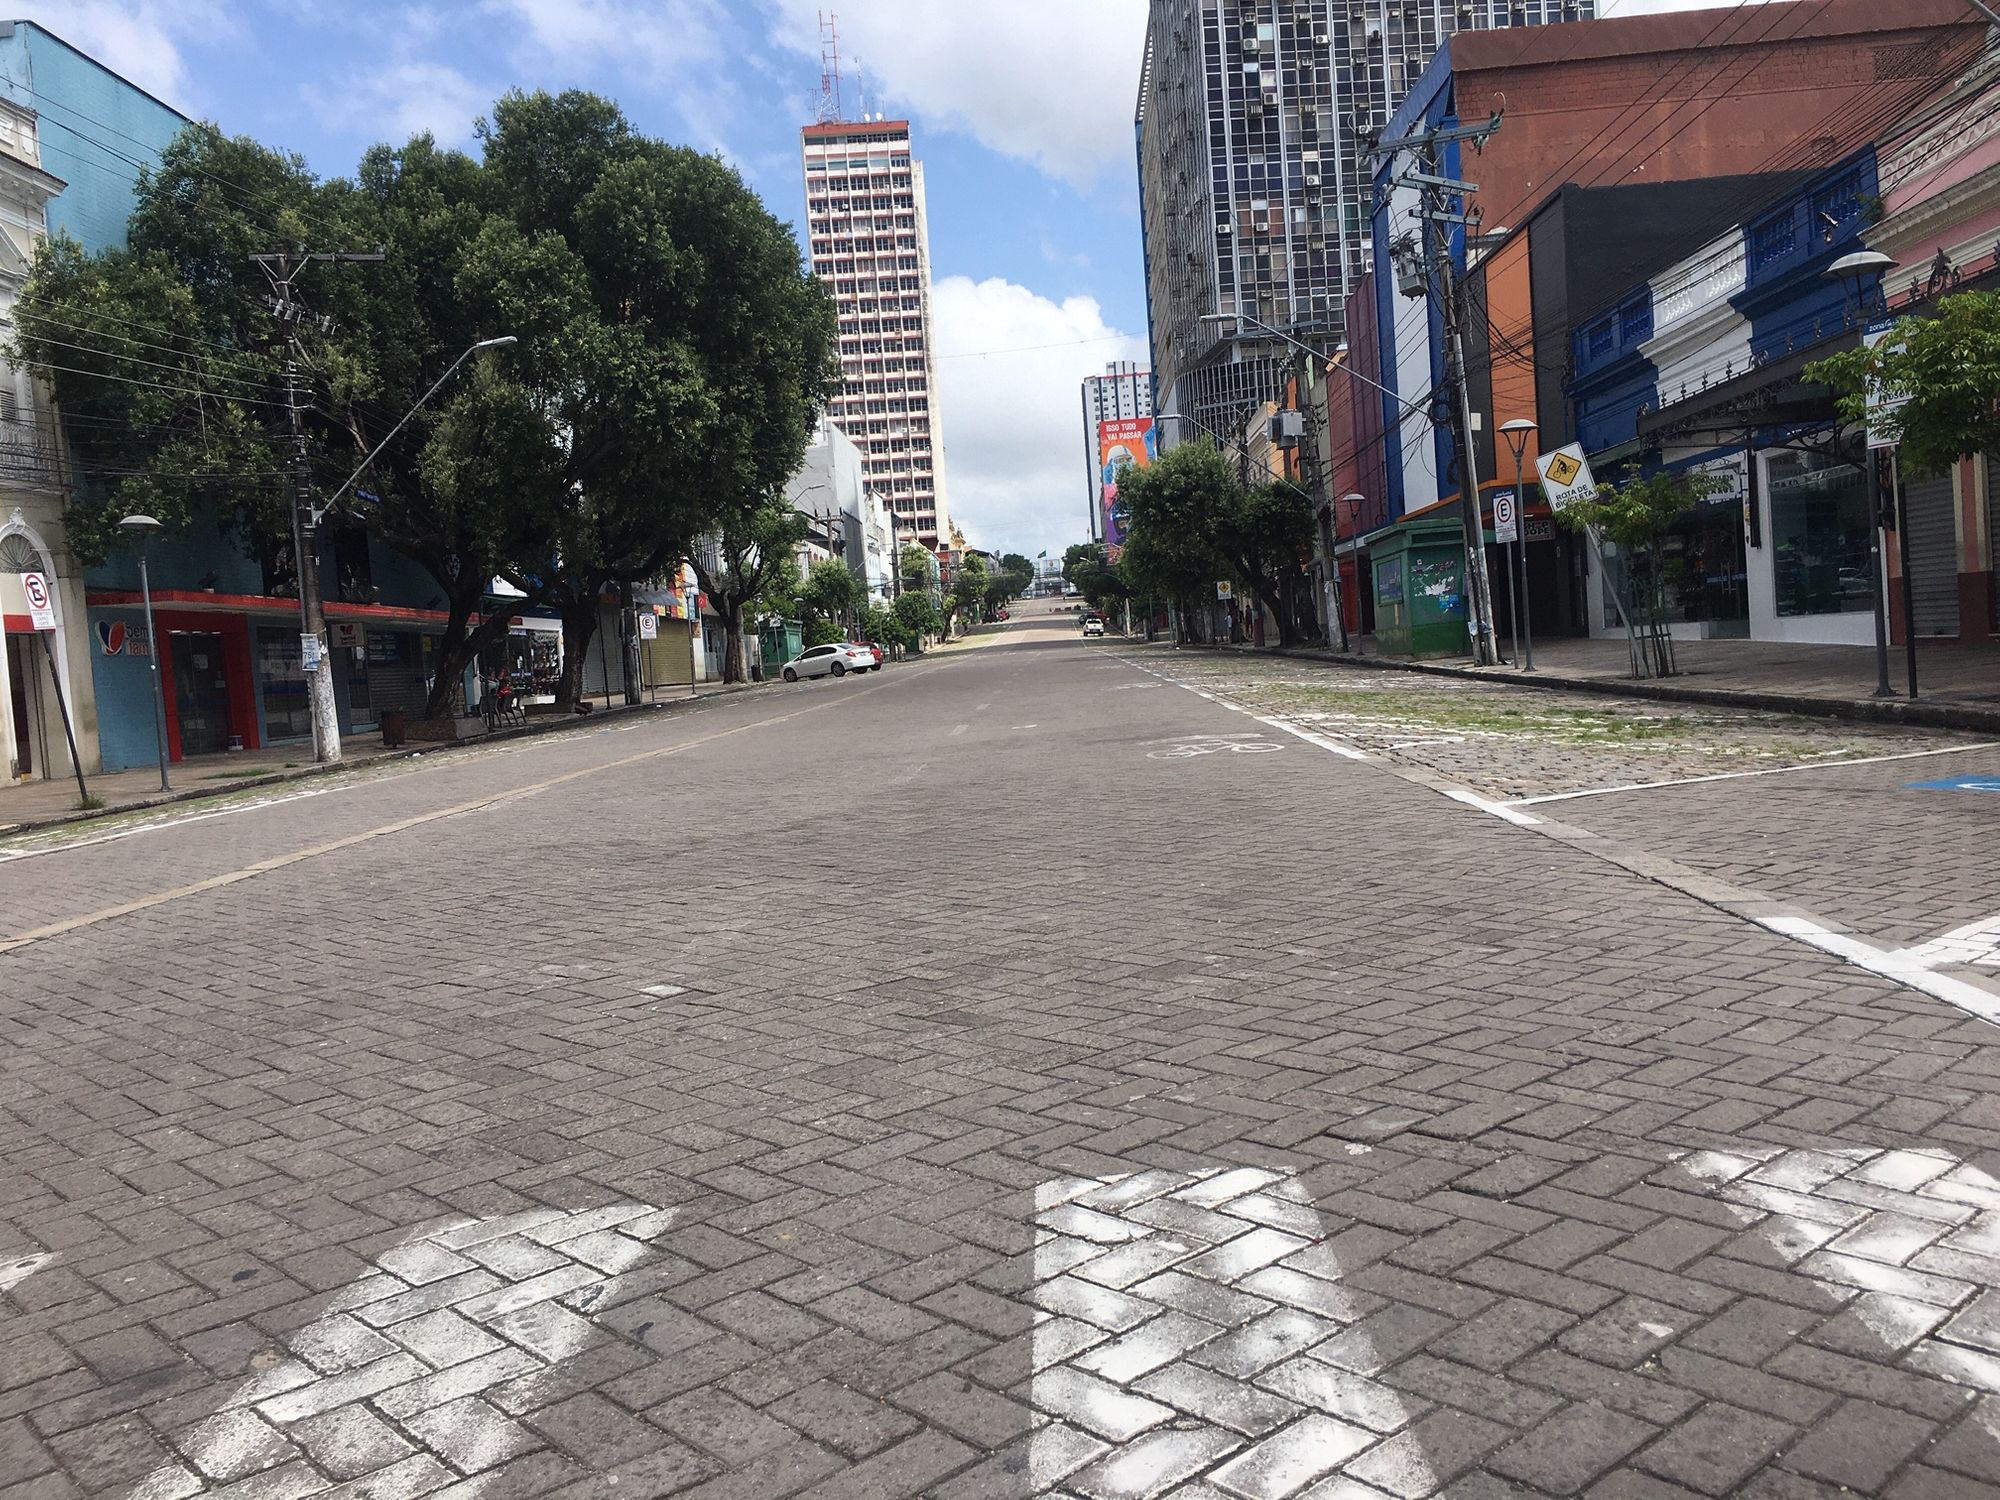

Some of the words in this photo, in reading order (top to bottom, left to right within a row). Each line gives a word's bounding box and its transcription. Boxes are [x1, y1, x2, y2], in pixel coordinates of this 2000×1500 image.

[1105, 424, 1119, 432] ISSO
[1121, 422, 1136, 431] TUDO
[1106, 432, 1118, 440] VAI
[1119, 431, 1142, 440] PASSAR
[1554, 490, 1595, 509] BICICLETA
[1555, 489, 1577, 501] ROTA
[1576, 484, 1589, 493] DE
[1500, 503, 1508, 517] E
